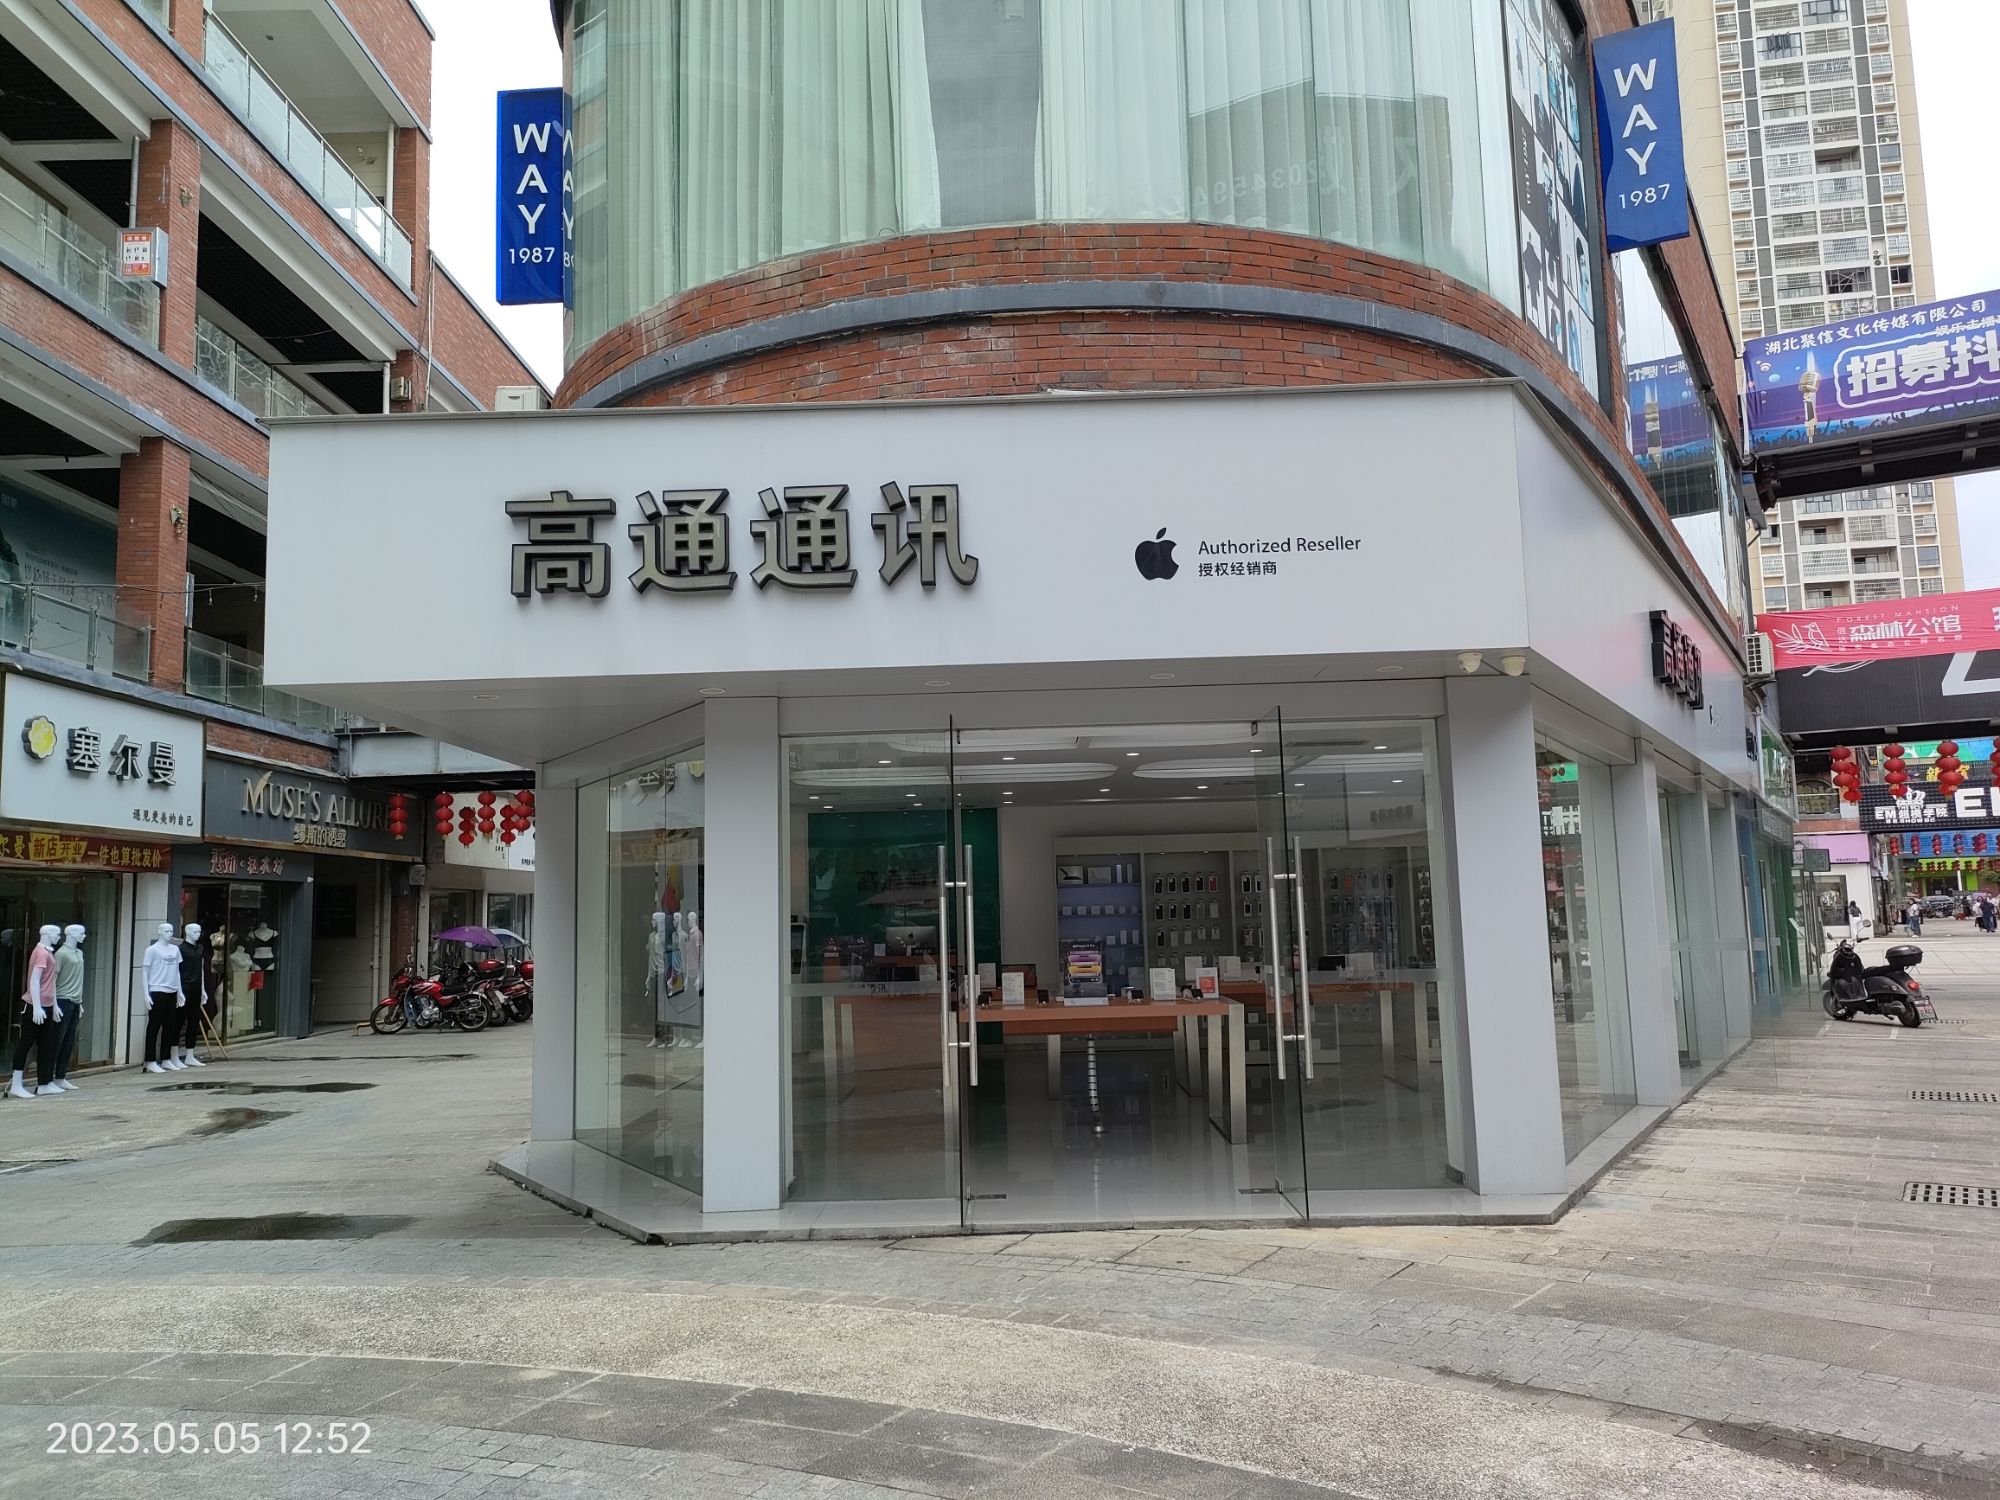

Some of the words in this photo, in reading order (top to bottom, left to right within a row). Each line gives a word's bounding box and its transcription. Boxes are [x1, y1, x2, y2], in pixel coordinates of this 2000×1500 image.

[1613, 58, 1658, 176] WAY
[513, 122, 551, 235] WAY
[1618, 183, 1671, 209] 1987
[508, 247, 555, 264] 1987
[1764, 299, 1987, 356] 湖北聚信文化传媒有限公司
[505, 480, 980, 598] 高通通讯
[1198, 538, 1291, 555] Authorized
[1296, 535, 1361, 552] Reseller
[1198, 561, 1277, 577] 授权经销商
[1849, 614, 1962, 643] 森林公馆
[66, 726, 177, 787] 塞尔曼
[132, 808, 194, 827] 遇见更美的自己
[33, 836, 83, 858] 新店开业
[87, 843, 162, 869] 一件也算批发价
